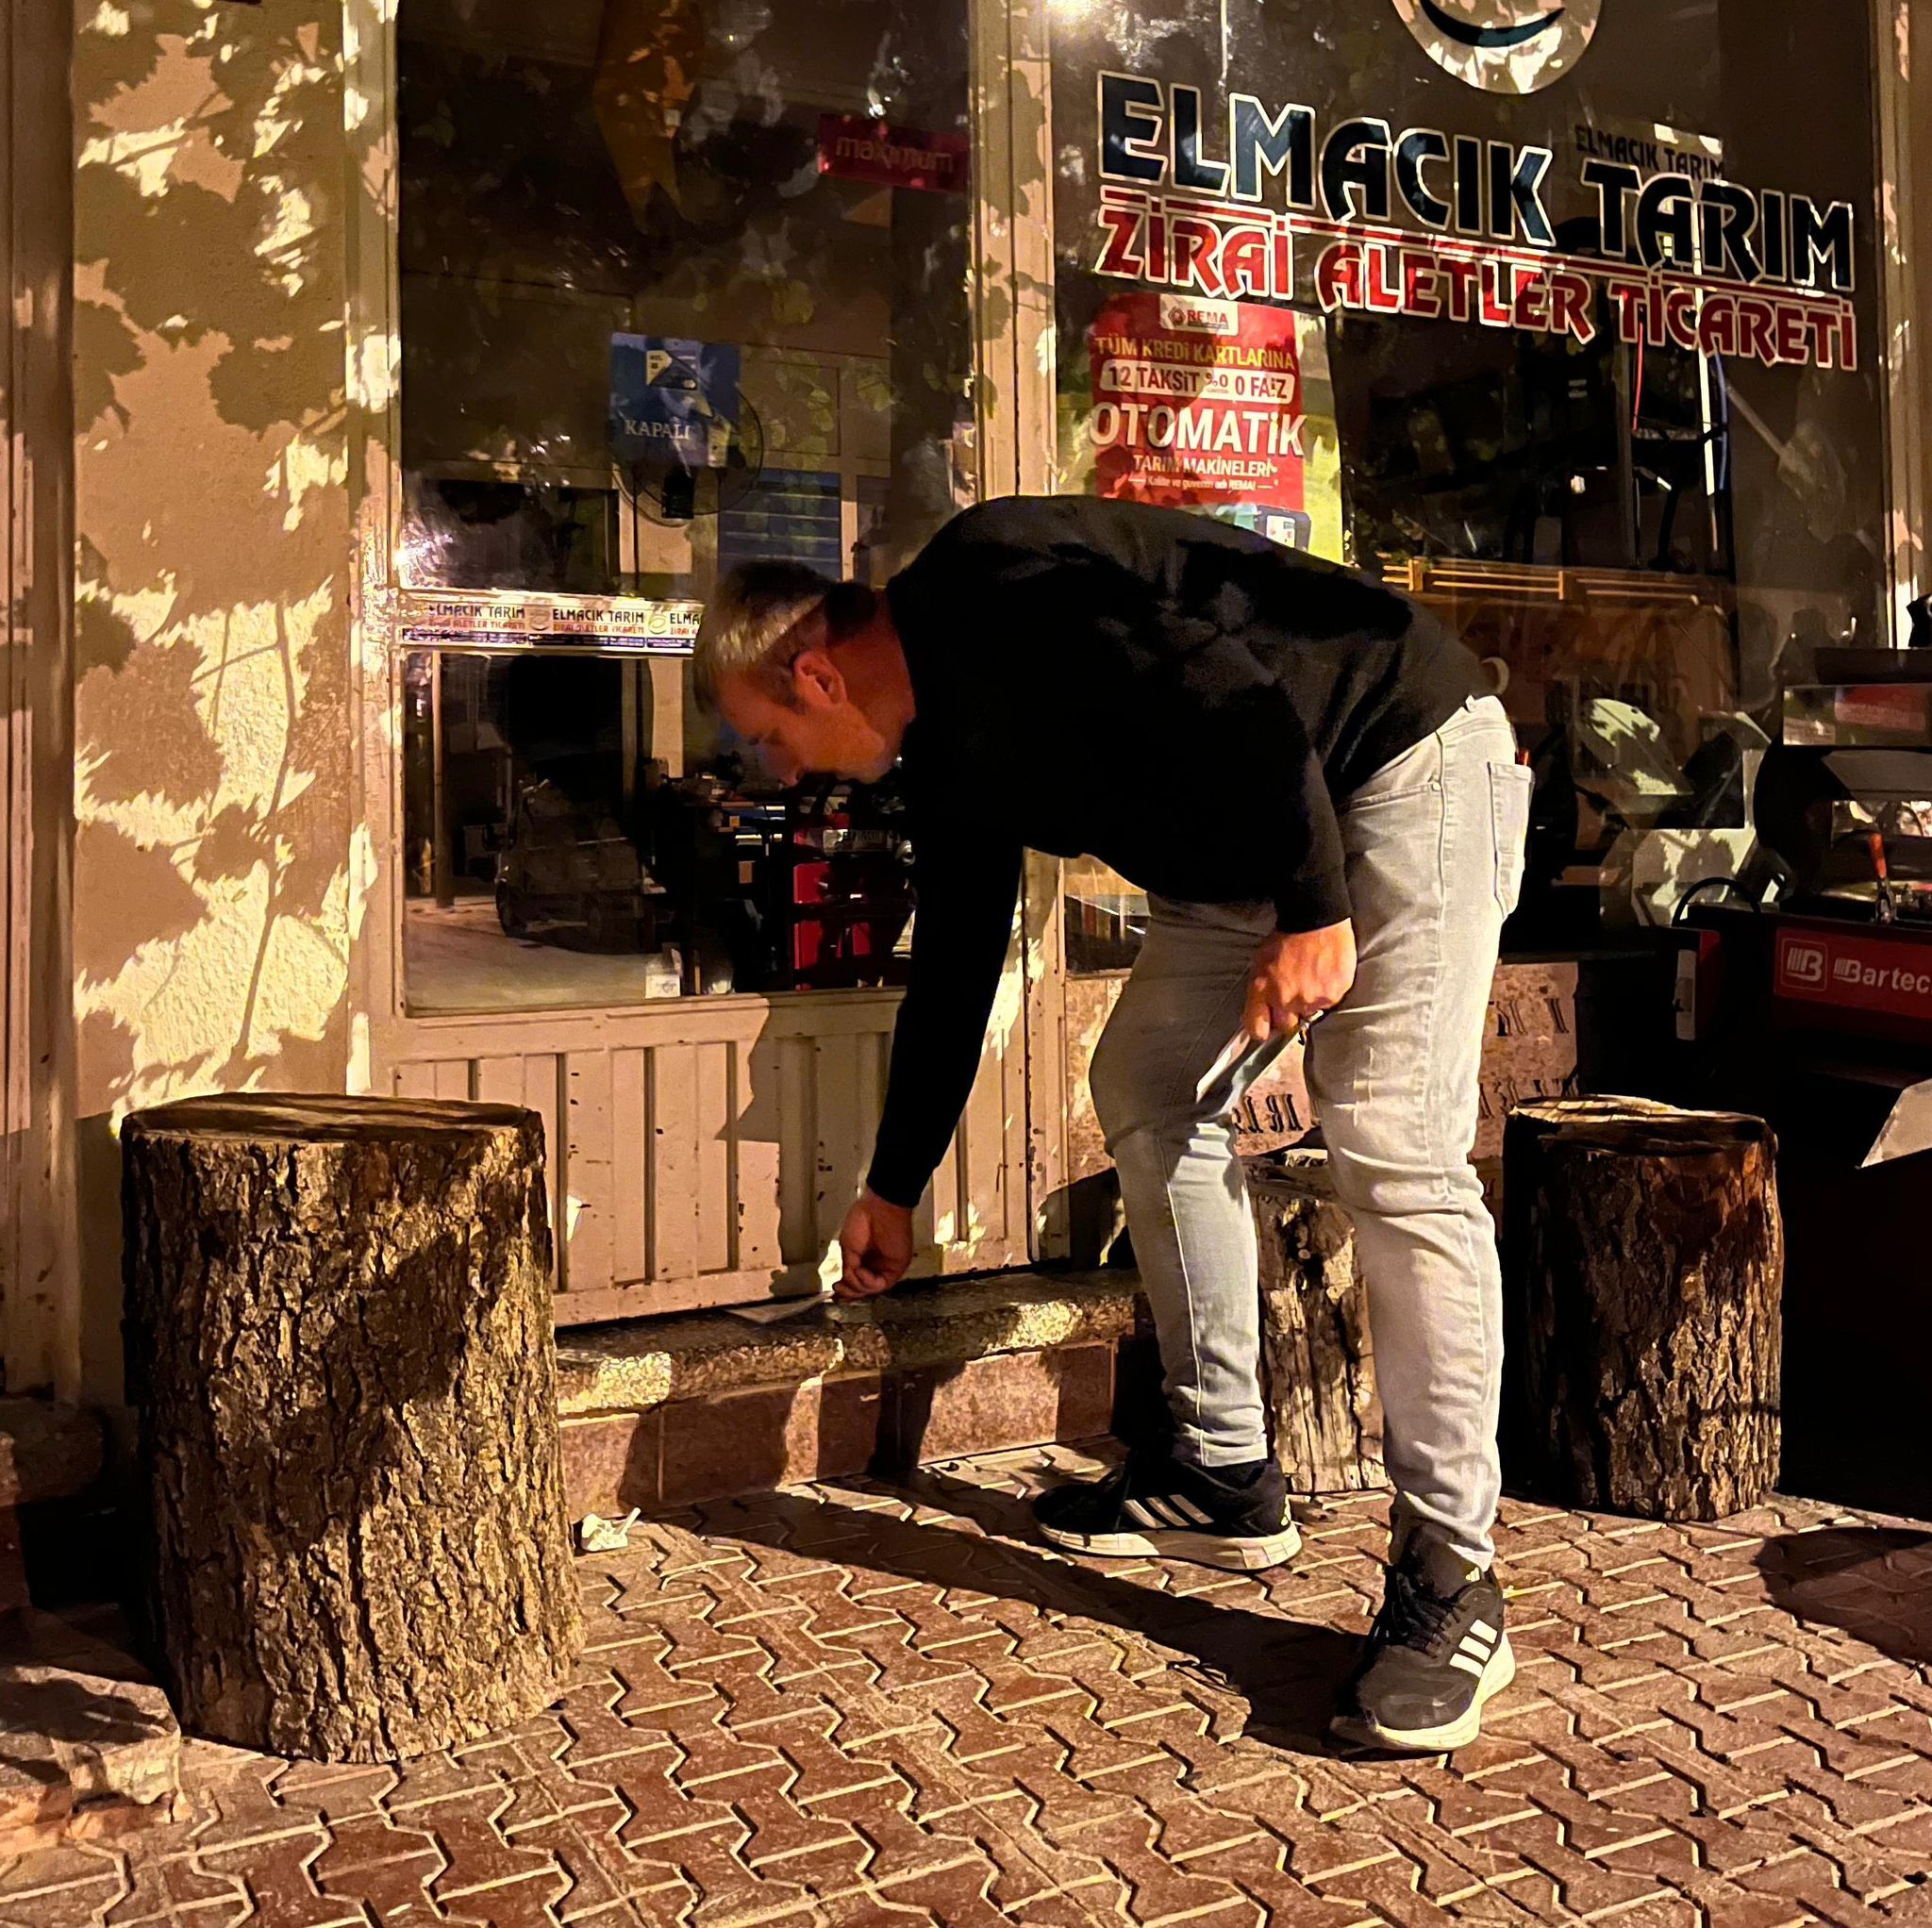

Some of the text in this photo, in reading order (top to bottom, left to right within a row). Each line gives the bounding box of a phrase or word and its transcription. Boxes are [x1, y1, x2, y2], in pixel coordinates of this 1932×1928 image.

[1574, 125, 1724, 180] ELMACIK TARIM
[1097, 69, 1856, 292] ELMACIK TARIM
[1095, 199, 1857, 373] ZİRAİ ALETLER TİCARETİ
[1187, 309, 1228, 324] REMA
[1095, 335, 1295, 371] TÜM KREDİ KARTLARINA
[1109, 366, 1131, 386] 12
[1136, 365, 1200, 392] TAKSİT
[1250, 377, 1287, 399] FAİZ
[624, 419, 691, 440] KAPALI
[1090, 402, 1307, 457] OTOMATİK
[1134, 454, 1272, 478] TARIM MAKİNELERİ
[486, 606, 525, 620] TARIM
[552, 608, 644, 623] ELMACIK TARIM
[1833, 956, 1932, 994] Bartec
